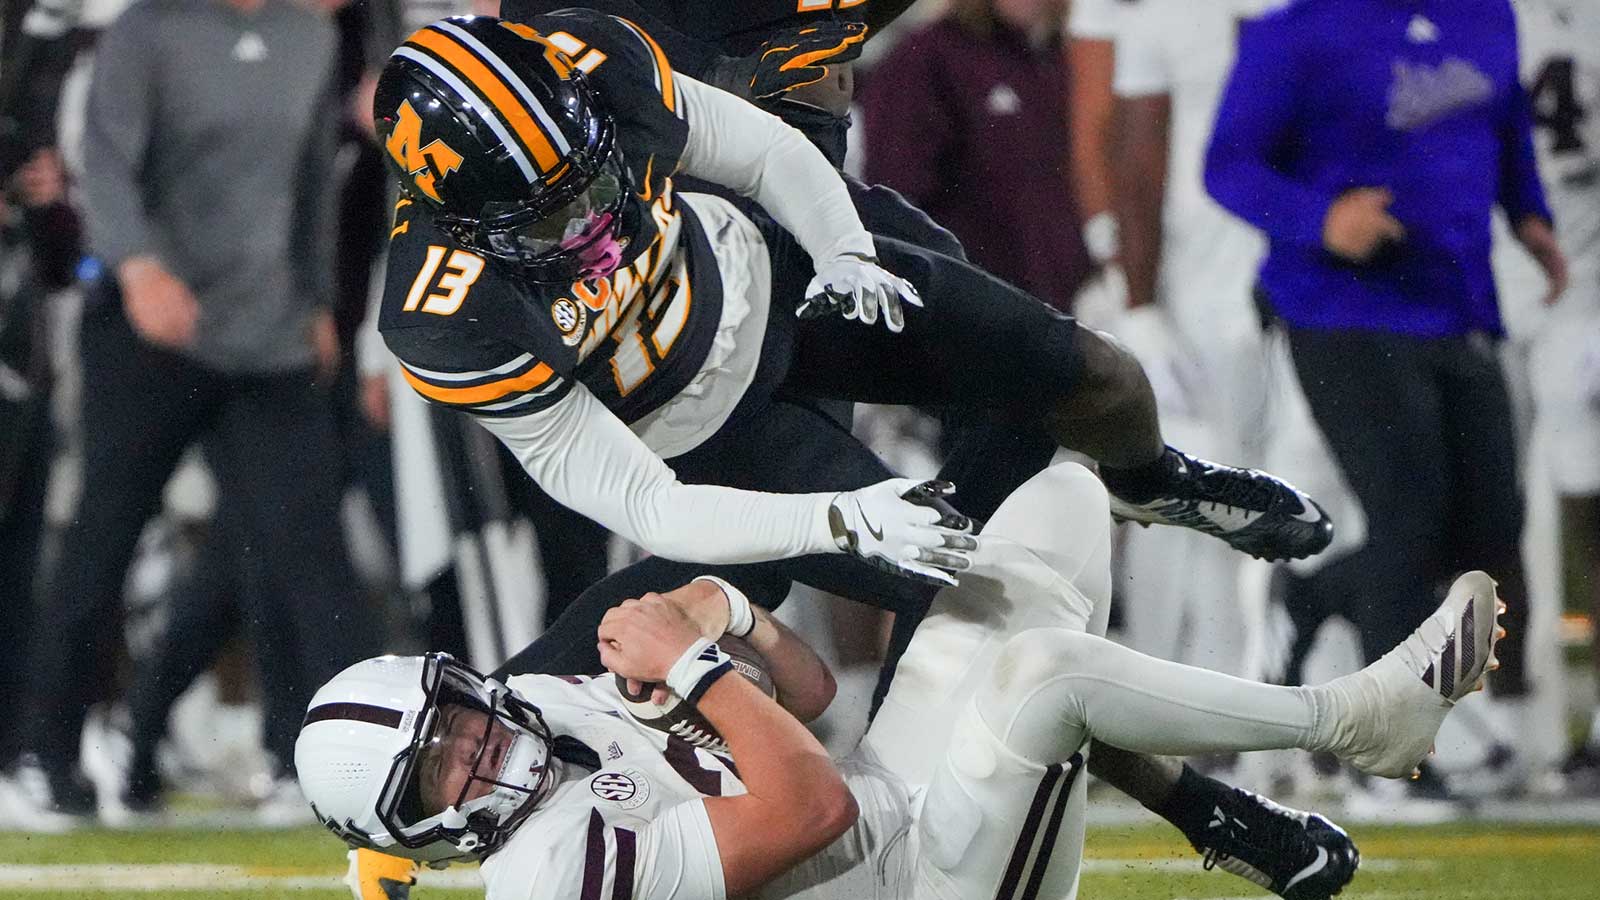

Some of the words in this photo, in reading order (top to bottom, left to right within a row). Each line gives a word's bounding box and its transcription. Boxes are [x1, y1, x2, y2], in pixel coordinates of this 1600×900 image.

[386, 98, 464, 204] M
[403, 245, 485, 315] 13
[571, 276, 612, 312] C
[553, 299, 578, 331] SEC
[591, 773, 636, 801] SEC
